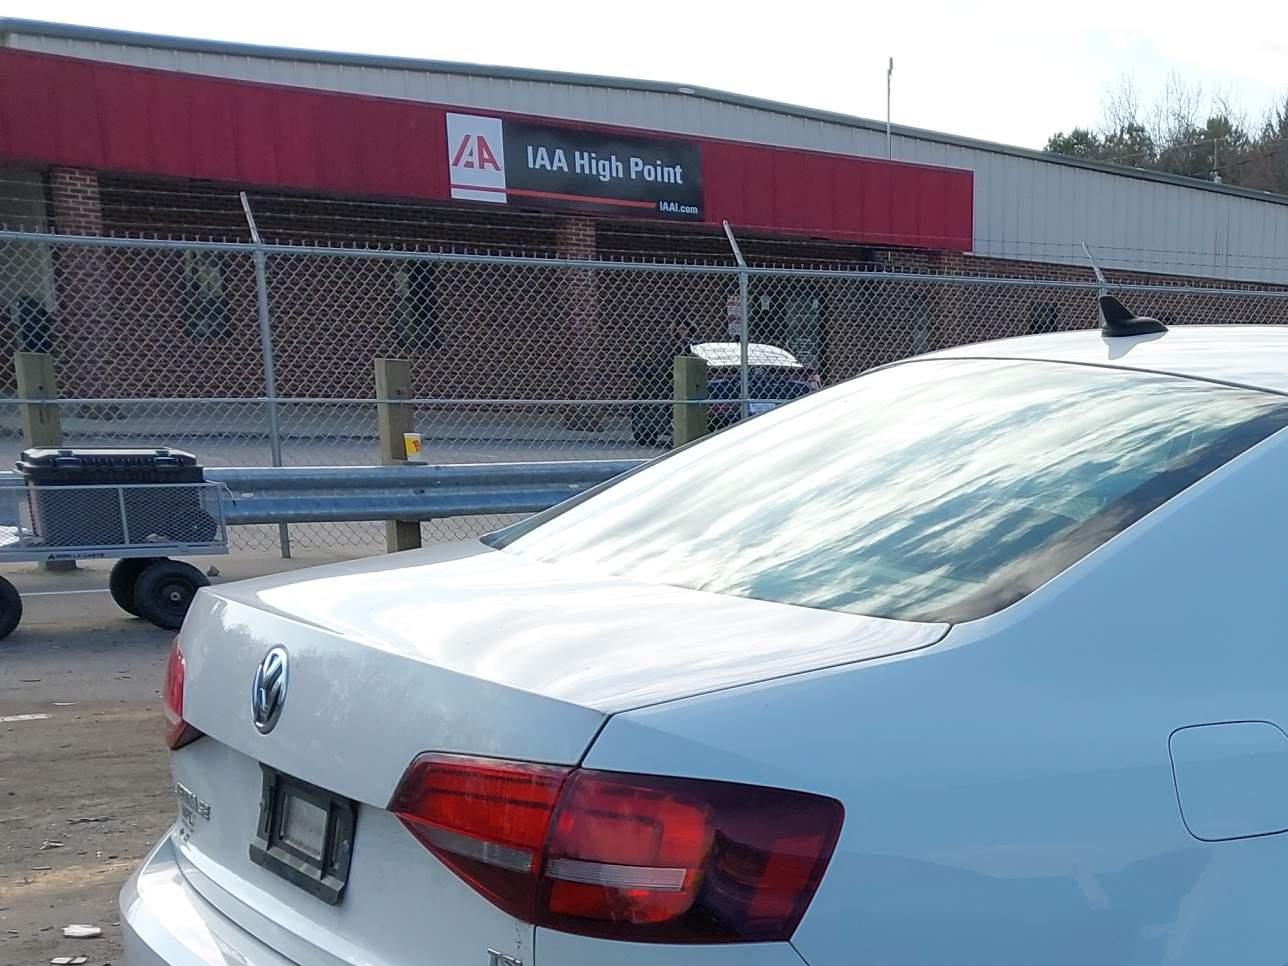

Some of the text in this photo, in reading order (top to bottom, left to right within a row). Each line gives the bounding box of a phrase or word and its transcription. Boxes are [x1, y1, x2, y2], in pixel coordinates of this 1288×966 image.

[526, 145, 684, 185] IAA High Point
[659, 200, 699, 215] IAAI.com
